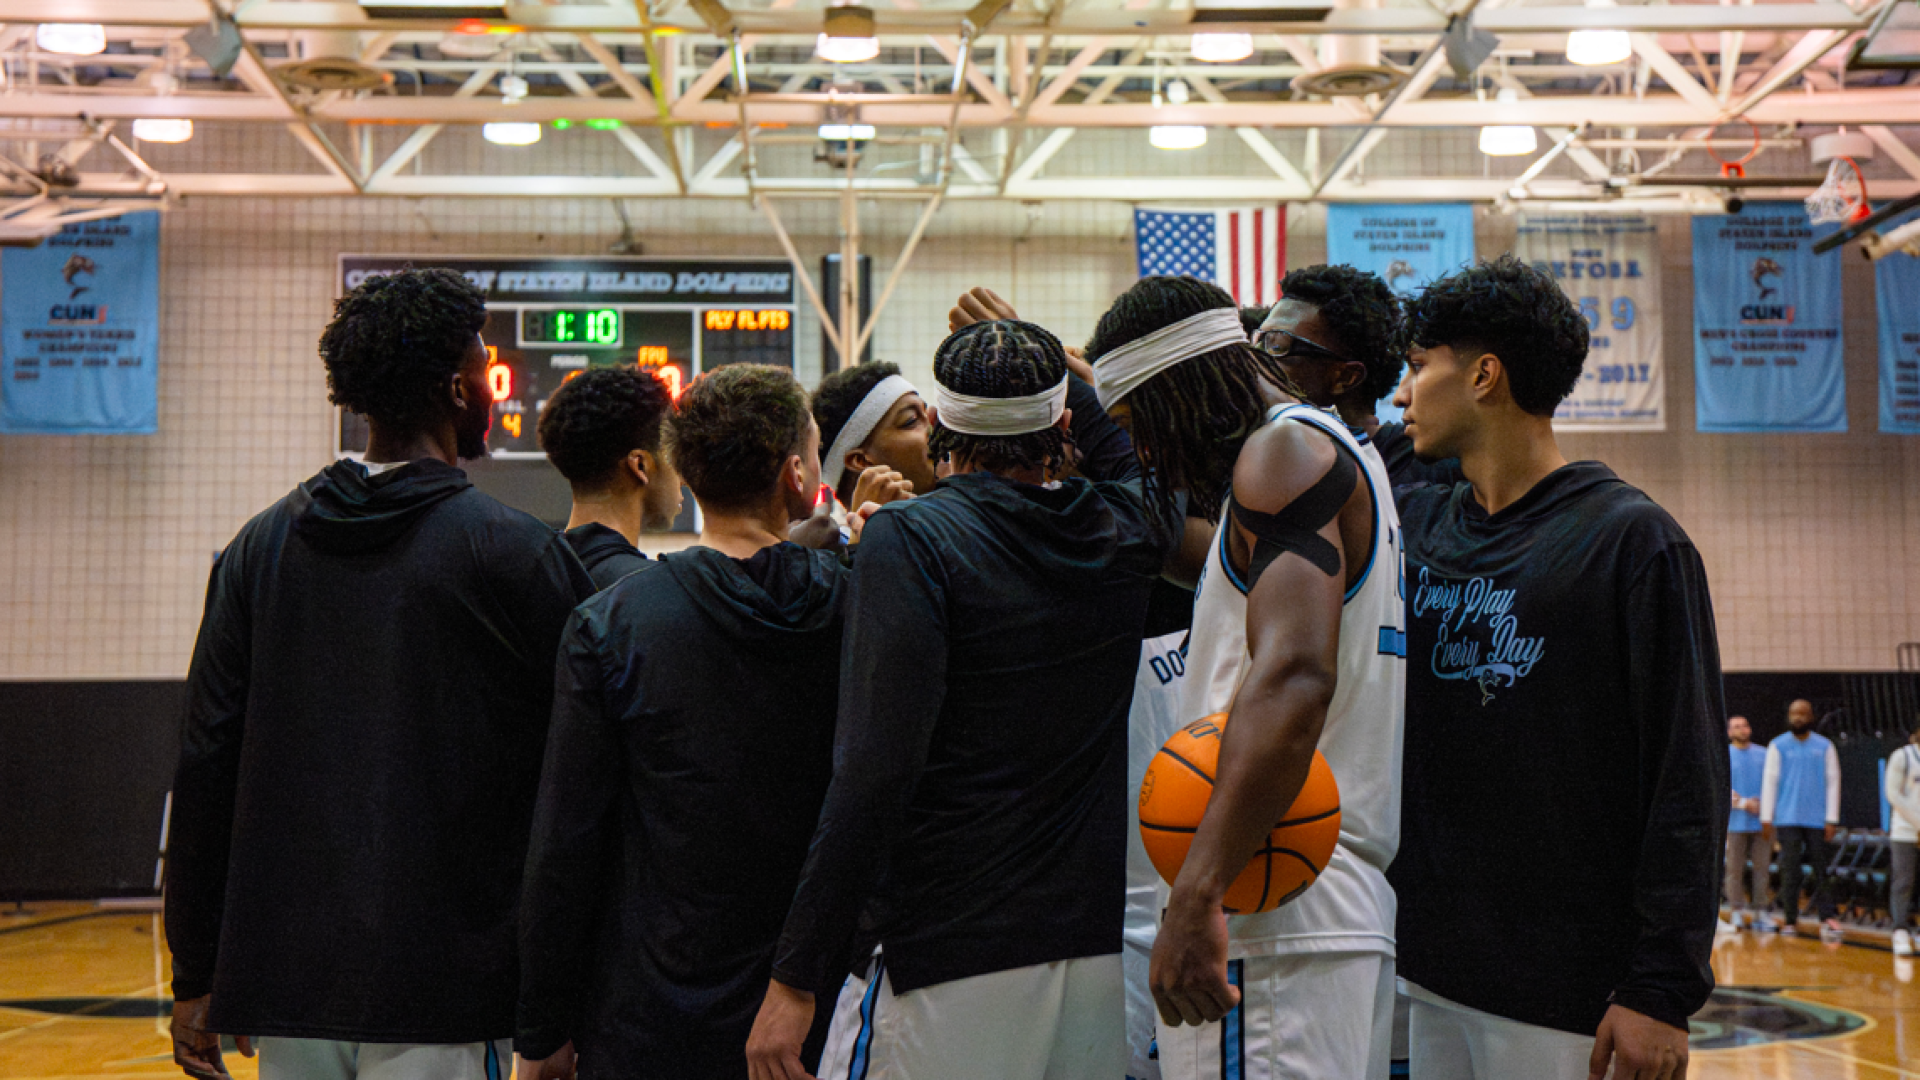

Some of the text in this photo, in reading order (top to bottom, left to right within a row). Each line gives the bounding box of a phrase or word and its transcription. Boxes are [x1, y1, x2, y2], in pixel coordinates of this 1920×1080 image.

[556, 310, 619, 344] 1:10
[502, 413, 521, 438] 4
[1414, 566, 1517, 632] Every Play
[1431, 615, 1545, 681] Every Day
[1149, 650, 1186, 685] DO
